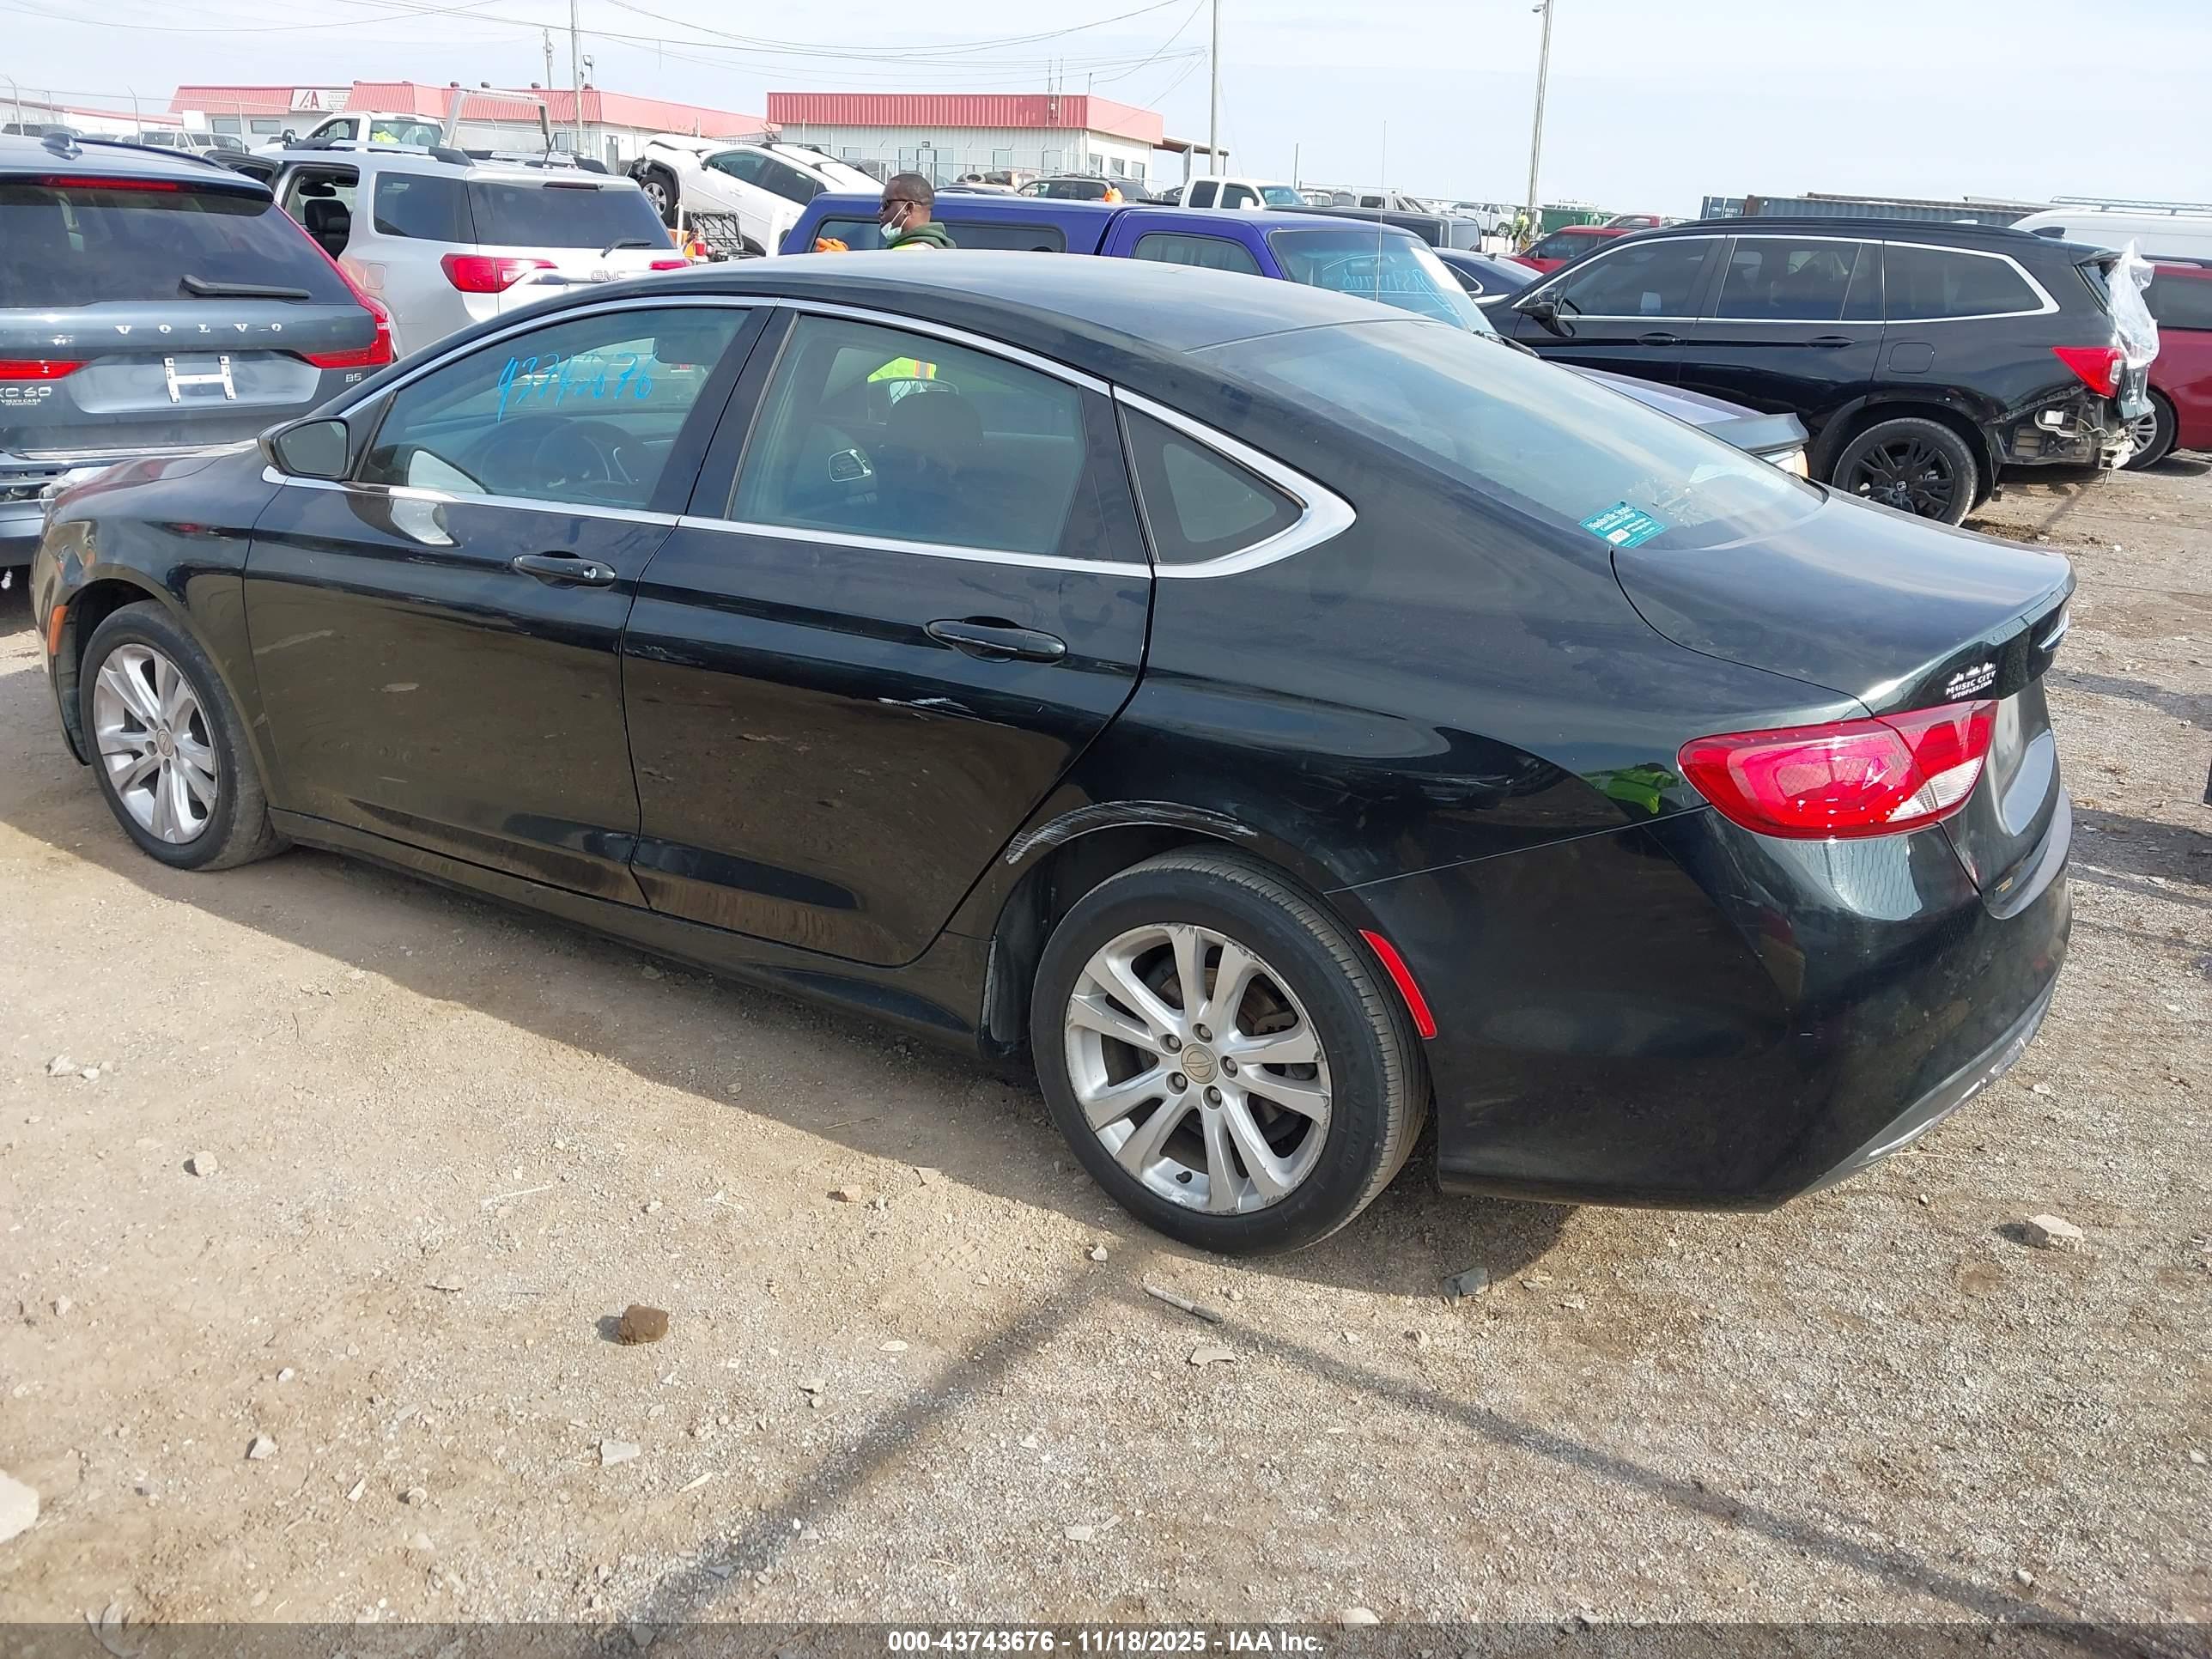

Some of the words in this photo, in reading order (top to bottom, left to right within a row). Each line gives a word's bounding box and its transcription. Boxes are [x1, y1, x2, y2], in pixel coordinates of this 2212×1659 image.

[591, 269, 626, 281] GMC
[114, 323, 283, 335] VOLVO
[345, 372, 362, 383] B5
[1945, 678, 1977, 696] MUSIC
[1977, 670, 1996, 684] CITY
